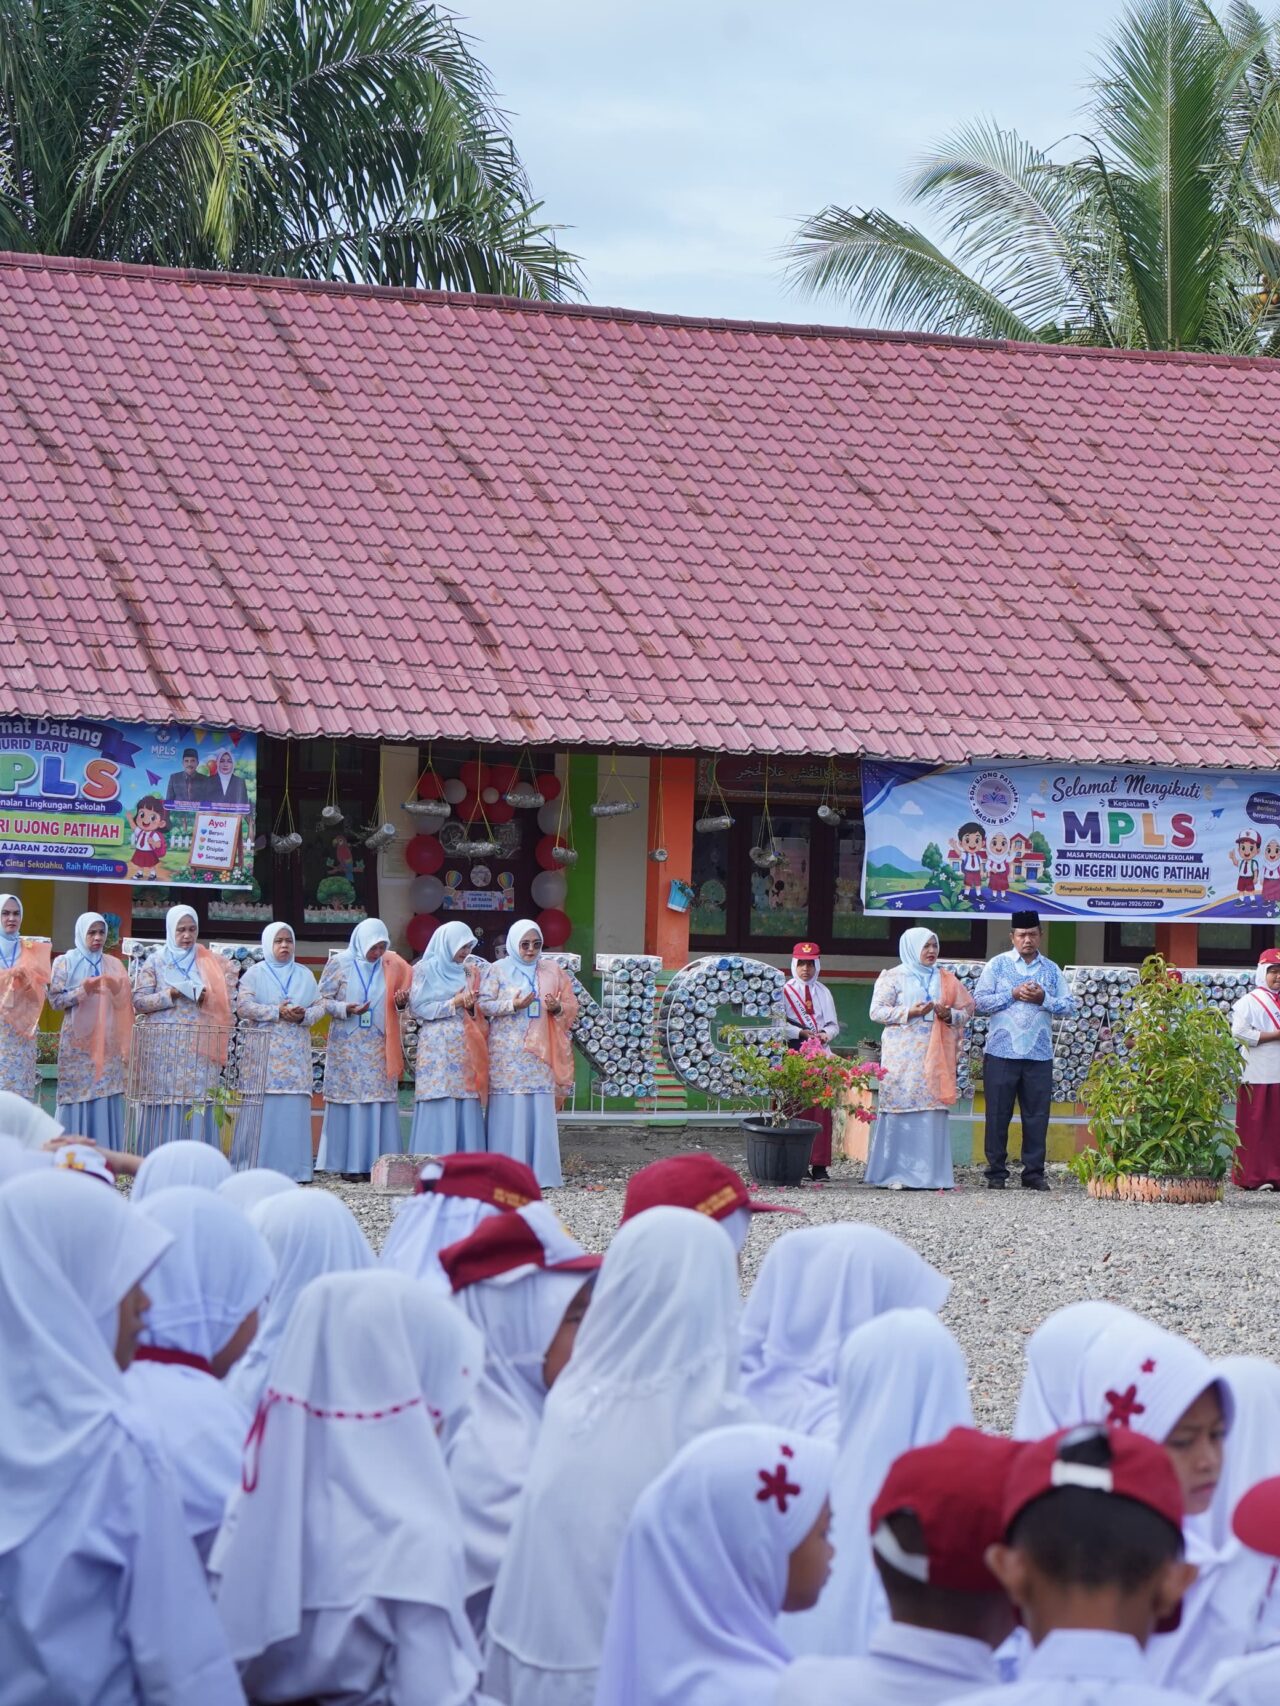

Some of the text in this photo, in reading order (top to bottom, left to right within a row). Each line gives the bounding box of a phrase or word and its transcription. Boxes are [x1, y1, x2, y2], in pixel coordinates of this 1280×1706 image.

[37, 719, 102, 747] Datang
[0, 738, 69, 753] URID BARU
[151, 745, 176, 755] MPLS
[975, 772, 998, 784] UJONG
[999, 774, 1019, 803] PATIHAH
[1052, 774, 1201, 802] Selamat Mengikuti
[25, 799, 72, 810] Lingkungan
[75, 802, 106, 811] Sekolah
[1113, 800, 1146, 808] Kegiatan
[14, 820, 59, 835] UJONG
[64, 823, 119, 838] PATIHAH
[209, 819, 227, 828] Ayo!
[1062, 811, 1196, 848] MPLS
[2, 843, 88, 855] AJARAN 2026/2027
[1066, 851, 1195, 862] MASA PENGENALAN LINGKUNGAN SEKOLAH
[5, 859, 26, 868] Cintai
[66, 862, 81, 870] Raih
[83, 863, 113, 872] Mimpiku
[1055, 863, 1210, 881] SD NEGERI UJONG PATIHAH
